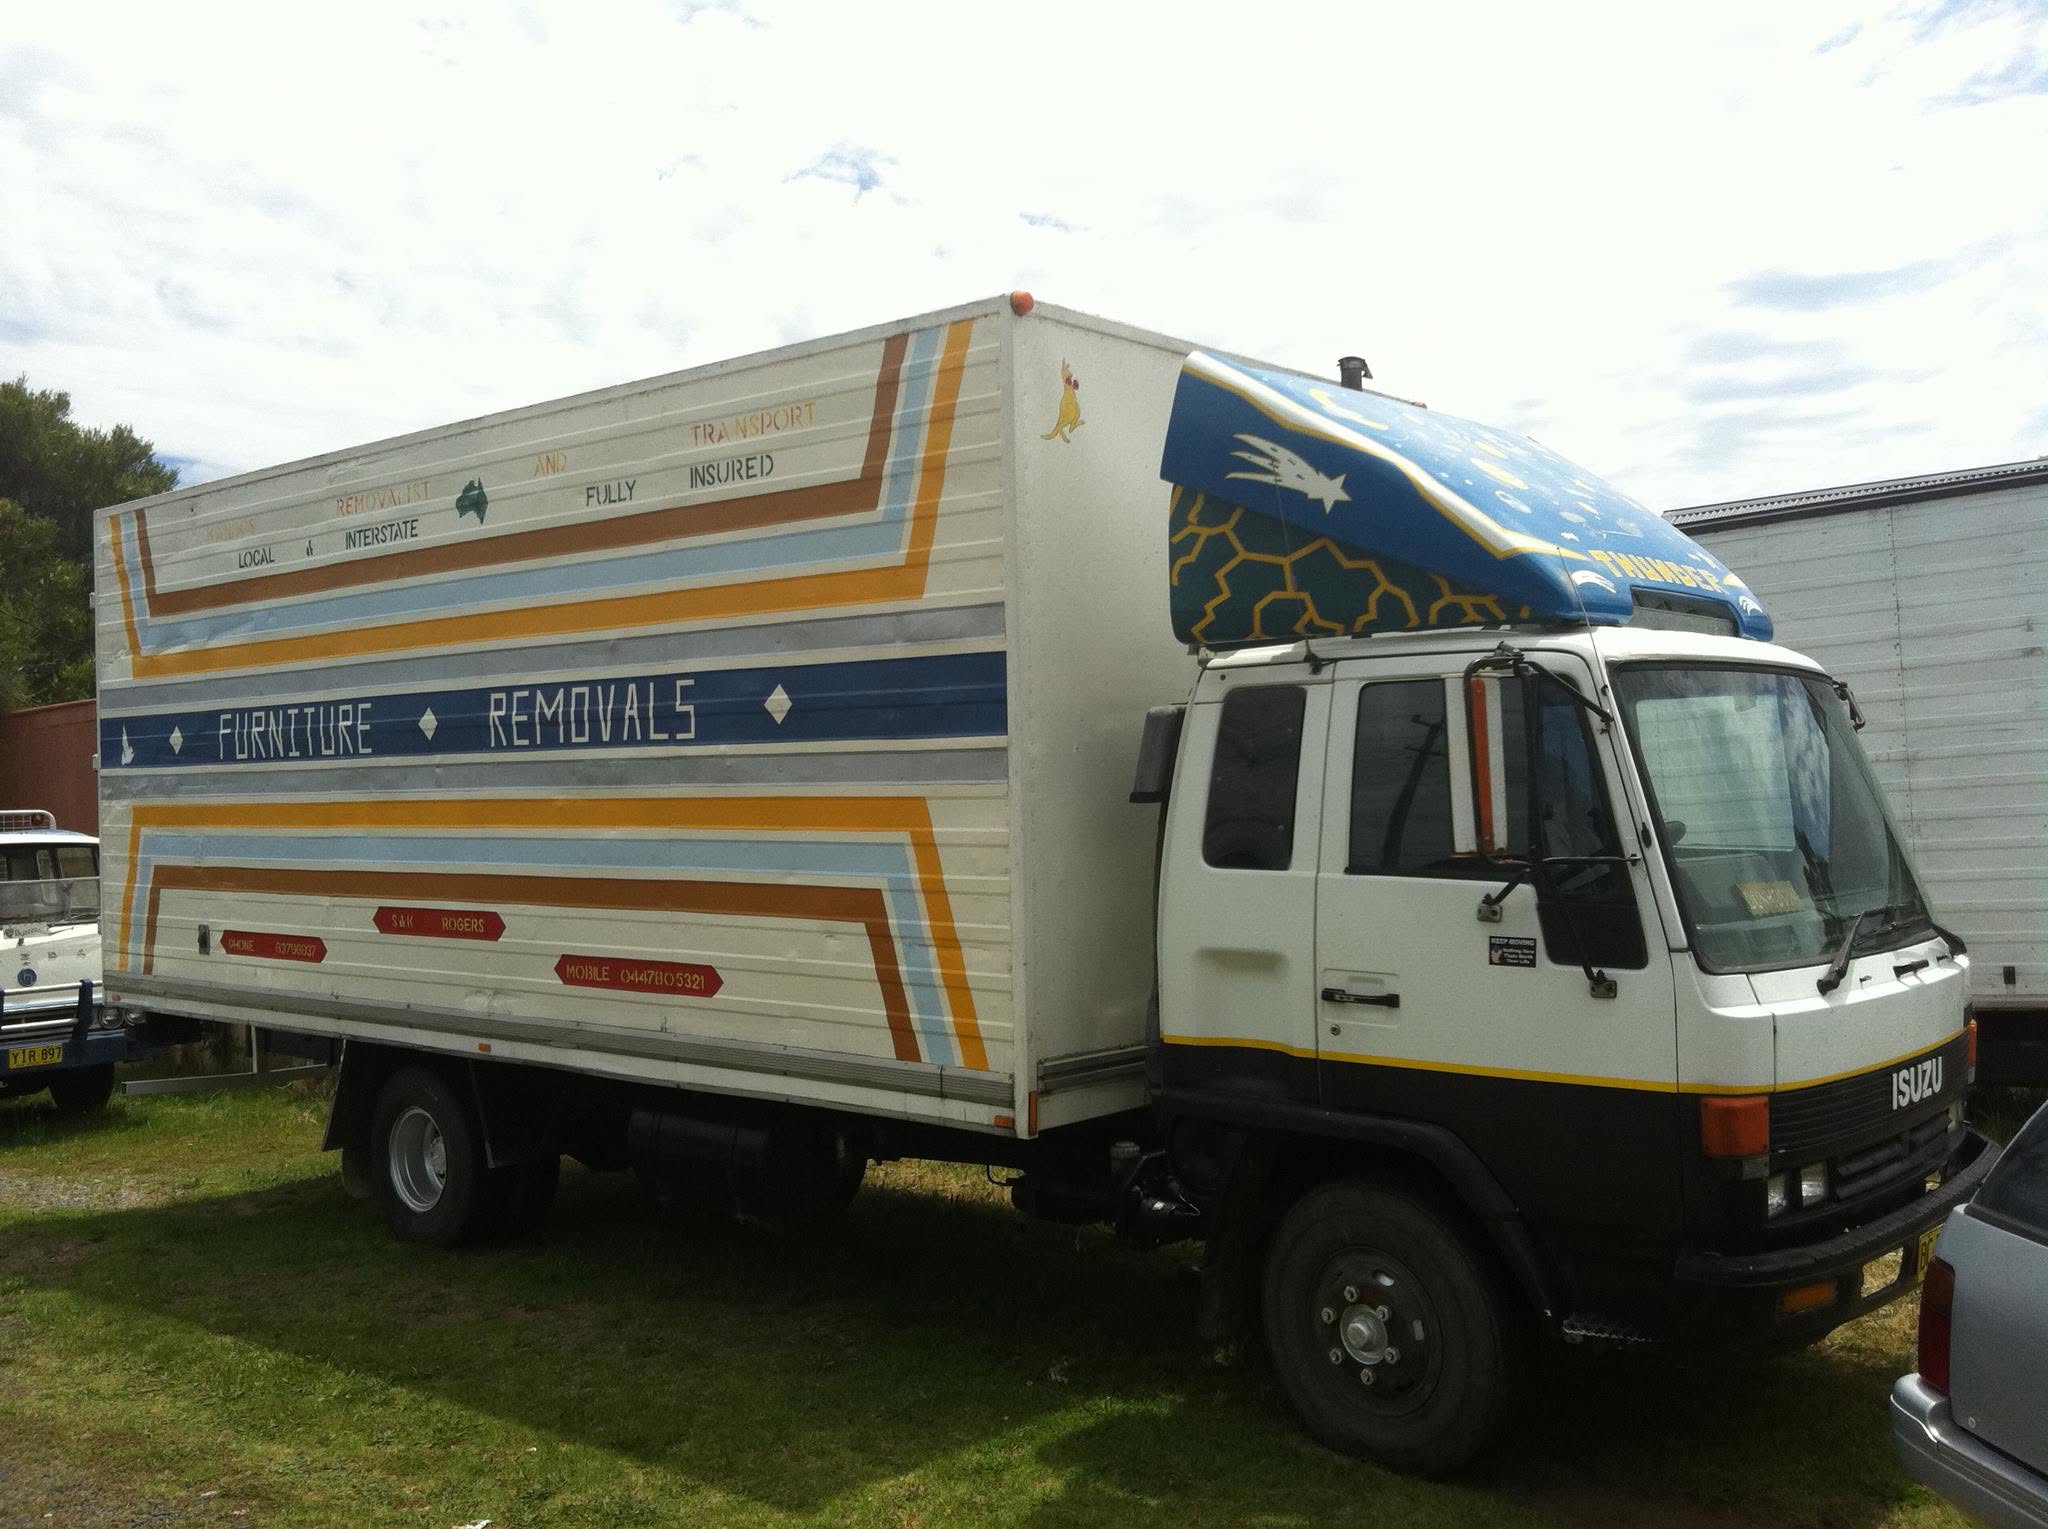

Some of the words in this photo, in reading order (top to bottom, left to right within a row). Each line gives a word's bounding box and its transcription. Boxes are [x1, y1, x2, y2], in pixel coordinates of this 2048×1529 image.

[534, 451, 568, 476] AND
[690, 403, 816, 446] TRANSPORT
[238, 547, 275, 569] LOCAL
[345, 519, 419, 550] INTERSTATE
[586, 479, 637, 507] FULLY
[690, 454, 774, 489] INSURED
[1588, 549, 1730, 595] THUNDER
[218, 703, 372, 760] FURNITURE
[489, 679, 696, 748] REMOVALS
[441, 917, 485, 933] ROGERS
[566, 964, 610, 982] MOBILE
[41, 1045, 62, 1060] 897
[1892, 1056, 1943, 1110] ISUZU
